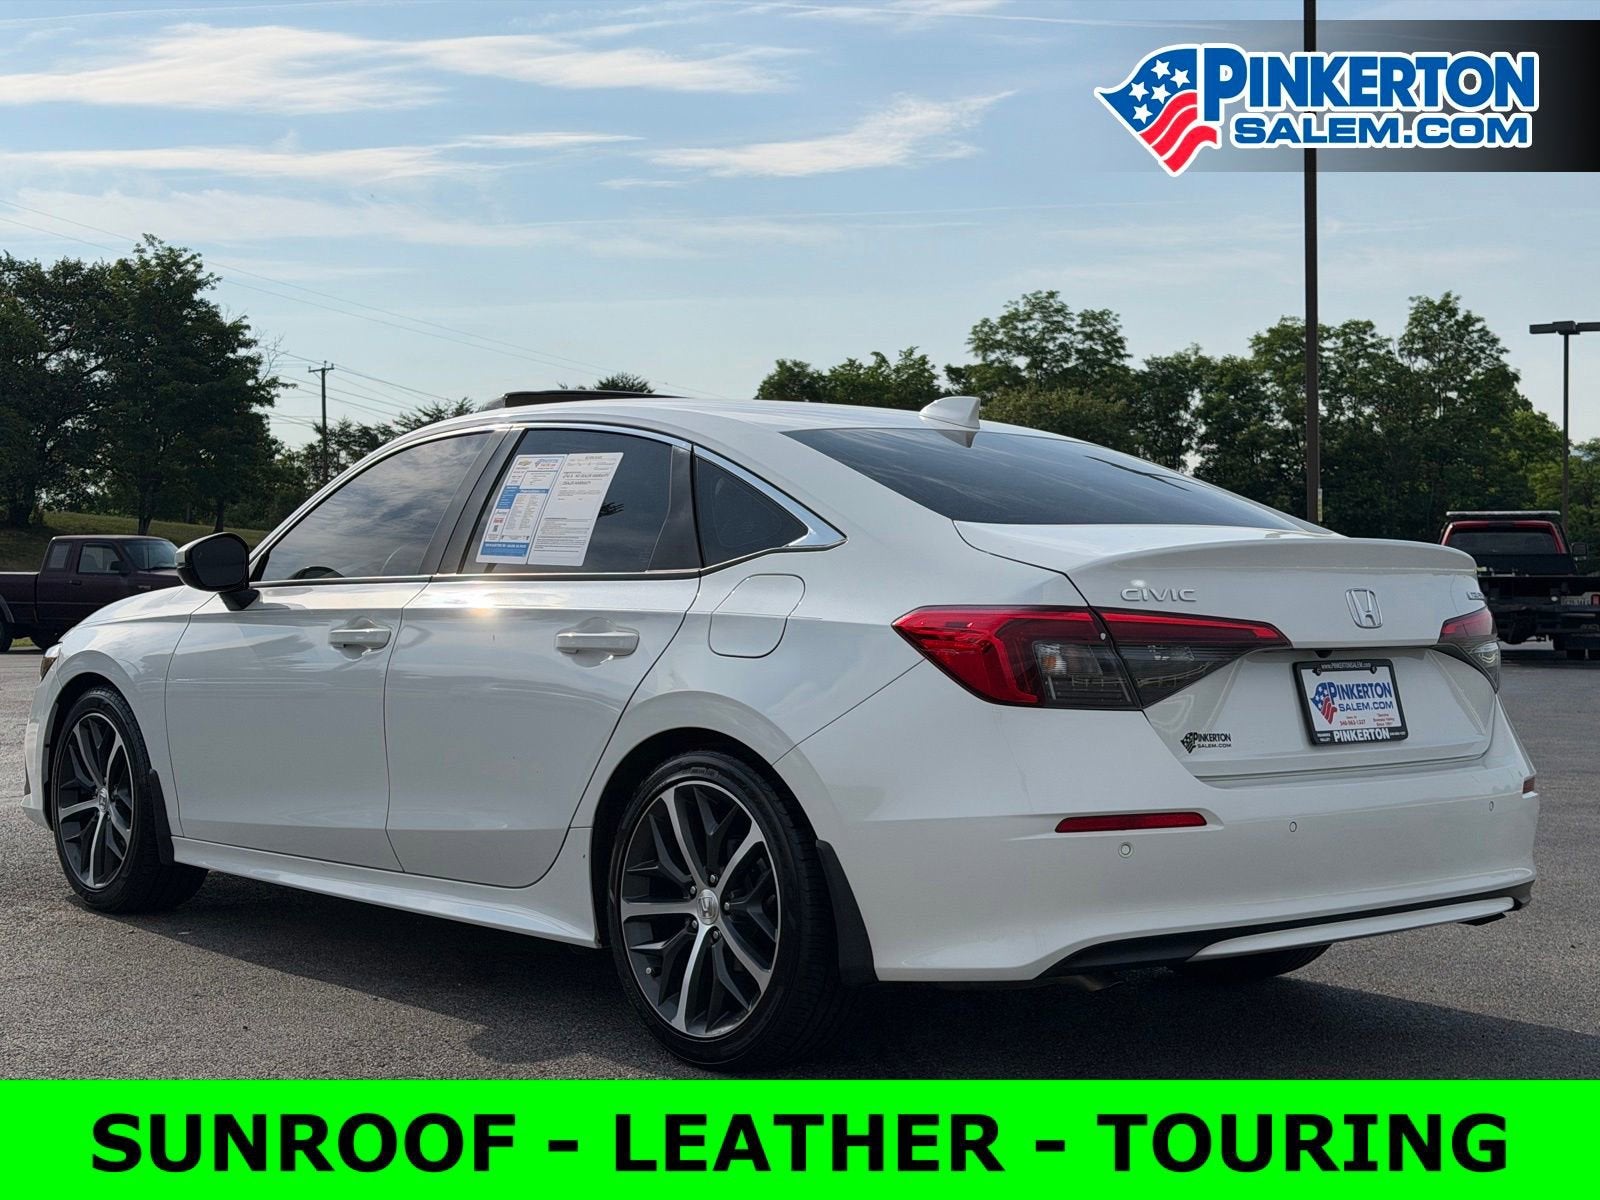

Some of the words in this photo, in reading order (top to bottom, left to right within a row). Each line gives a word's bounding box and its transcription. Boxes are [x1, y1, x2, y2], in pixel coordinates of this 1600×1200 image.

[1121, 588, 1197, 602] CIVIC
[1329, 681, 1393, 705] PINKERTON
[1339, 701, 1394, 712] SALEM.COM
[1193, 732, 1231, 745] PINKERTON
[1333, 728, 1391, 742] PINKERTON
